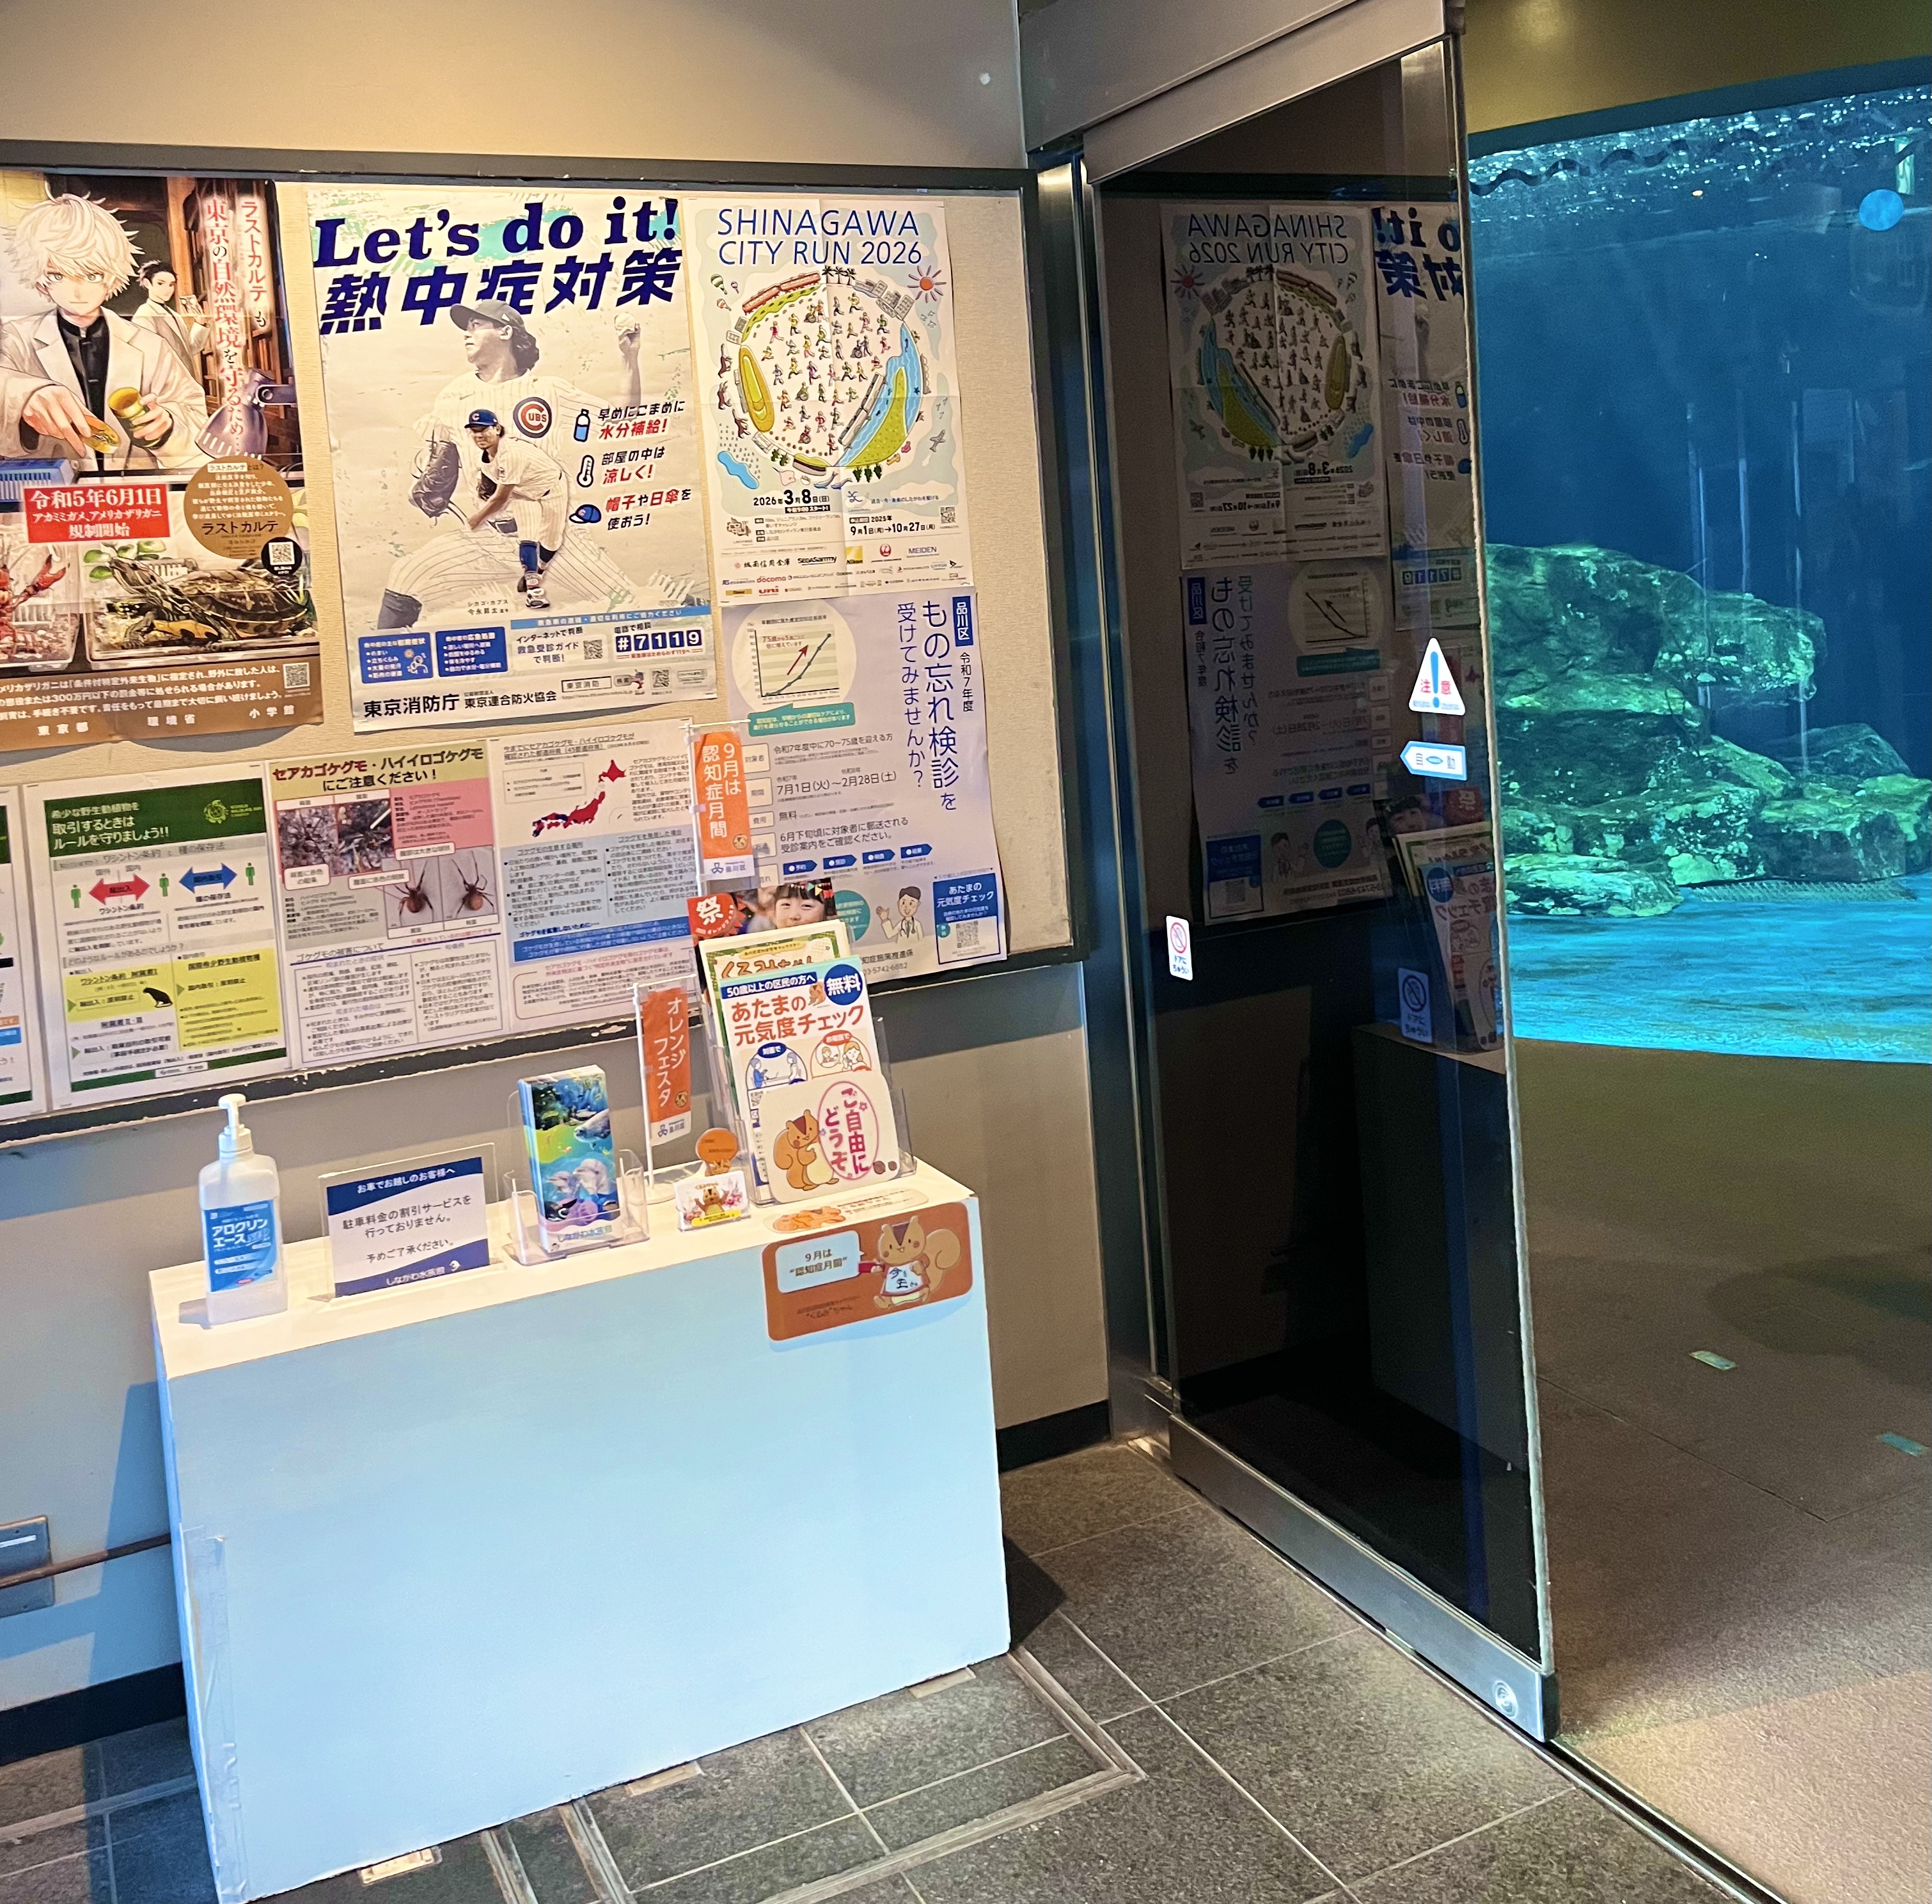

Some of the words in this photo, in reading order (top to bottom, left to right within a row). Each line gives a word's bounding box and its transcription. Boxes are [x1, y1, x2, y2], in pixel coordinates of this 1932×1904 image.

[313, 208, 479, 267] Let's
[503, 202, 584, 255] do
[605, 196, 679, 244] it!
[718, 208, 919, 237] SHINAGAWA
[241, 201, 267, 327] ラストカルテも
[718, 240, 779, 265] CITY
[794, 241, 850, 265] RUN
[861, 241, 922, 265] 2026
[320, 248, 684, 334] 熱中症対策
[597, 400, 685, 423] 早めにこまめに
[599, 421, 667, 441] 水分補給!
[602, 446, 665, 466] 部屋の中は
[603, 466, 652, 485] 涼しく!
[30, 487, 162, 510] 令和5年6月1日
[606, 487, 691, 513] 帽子や日傘を
[202, 520, 278, 535] ラストカルテ
[608, 513, 650, 531] 使おう!
[957, 602, 970, 640] 品川区
[516, 626, 583, 643] インターネットで判断
[617, 631, 700, 651] #7119
[961, 652, 974, 712] 令和7年度
[363, 694, 459, 718] 東京消防庁
[464, 690, 557, 709] 東京連合防火協会
[897, 602, 925, 788] 受けてみませんか?
[923, 601, 959, 810] もの忘れ検診を
[272, 748, 484, 782] セアカゴケグモ・ハイイロゴケグモ
[723, 743, 742, 796] 9月は
[323, 768, 437, 792] にご注意ください！
[702, 745, 727, 838] 認知症月間
[52, 816, 135, 835] 取引するときは
[53, 827, 169, 851] ルールを守りましょう!!
[936, 892, 994, 908] 元気度チェック
[948, 882, 982, 894] あたまの
[696, 895, 724, 925] 祭
[726, 974, 816, 997] 50歳以上の区民の方へ
[826, 973, 861, 996] 無料
[732, 995, 806, 1022] あたまの
[668, 997, 686, 1070] オレンジ
[735, 1005, 863, 1046] 元気度チェック
[654, 1037, 671, 1107] フェスタ
[825, 1106, 847, 1171] どうぞ
[841, 1088, 870, 1174] ご自由に
[357, 1168, 455, 1193] お車でお越しのお客様へ
[343, 1195, 471, 1230] 駐車料金の割引サービスを
[212, 1218, 268, 1237] アロクリン
[365, 1214, 452, 1238] 行っておりません。
[214, 1233, 246, 1247] エース
[366, 1239, 453, 1264] 予めご了承ください。
[805, 1248, 833, 1261] 9月は
